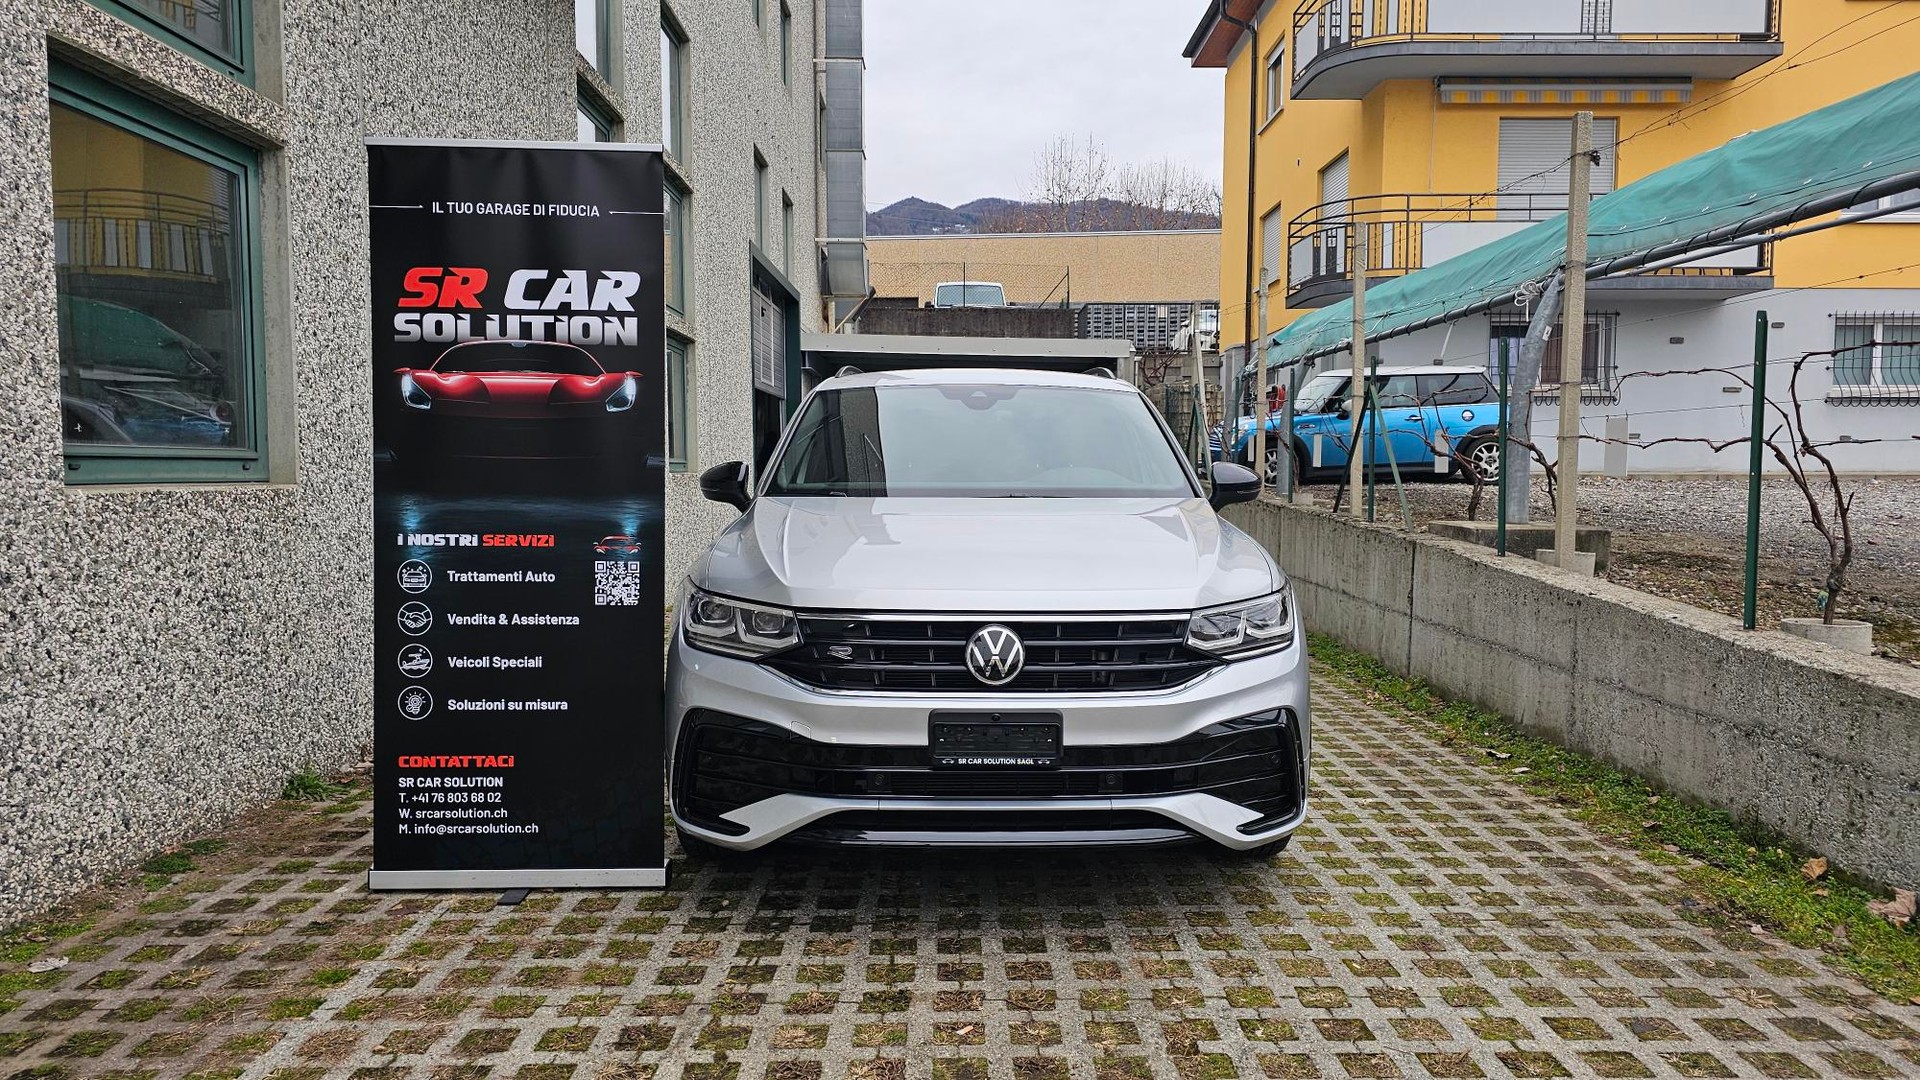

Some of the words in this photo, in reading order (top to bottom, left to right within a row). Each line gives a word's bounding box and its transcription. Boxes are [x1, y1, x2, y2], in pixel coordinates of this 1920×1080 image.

[432, 202, 443, 213] IL
[447, 202, 473, 214] TUO
[476, 203, 530, 215] GARAGE
[533, 204, 545, 215] DI
[549, 205, 600, 217] FIDUCIA
[397, 267, 488, 309] SR
[503, 269, 641, 312] CAR
[393, 312, 638, 346] SOLUTION
[397, 533, 403, 546] I
[407, 533, 478, 546] NOSTRI
[482, 534, 555, 547] SERVIZI
[447, 570, 523, 582] Trattamenti
[525, 571, 556, 582] Auto
[447, 613, 496, 625] Vendita
[498, 613, 508, 625] &
[511, 614, 580, 625] Assistenza
[967, 625, 1023, 683] VW
[447, 656, 490, 668] Veicoli
[492, 656, 543, 670] Speciali
[447, 699, 505, 711] Soluzioni
[507, 702, 522, 711] su
[525, 699, 568, 711] misura
[398, 755, 515, 768] CONTATTACI
[398, 777, 415, 788] SR
[416, 777, 441, 788] CAR
[443, 777, 503, 788] SOLUTION
[398, 793, 409, 803] T.
[411, 793, 429, 803] +41
[431, 793, 445, 803] 76
[447, 792, 468, 803] 803
[470, 792, 485, 803] 68
[487, 792, 502, 803] 02
[398, 808, 413, 819] W.
[415, 807, 508, 819] srcarsolution.ch
[398, 824, 412, 834] M.
[414, 823, 539, 835] info@srcarsolution.ch
